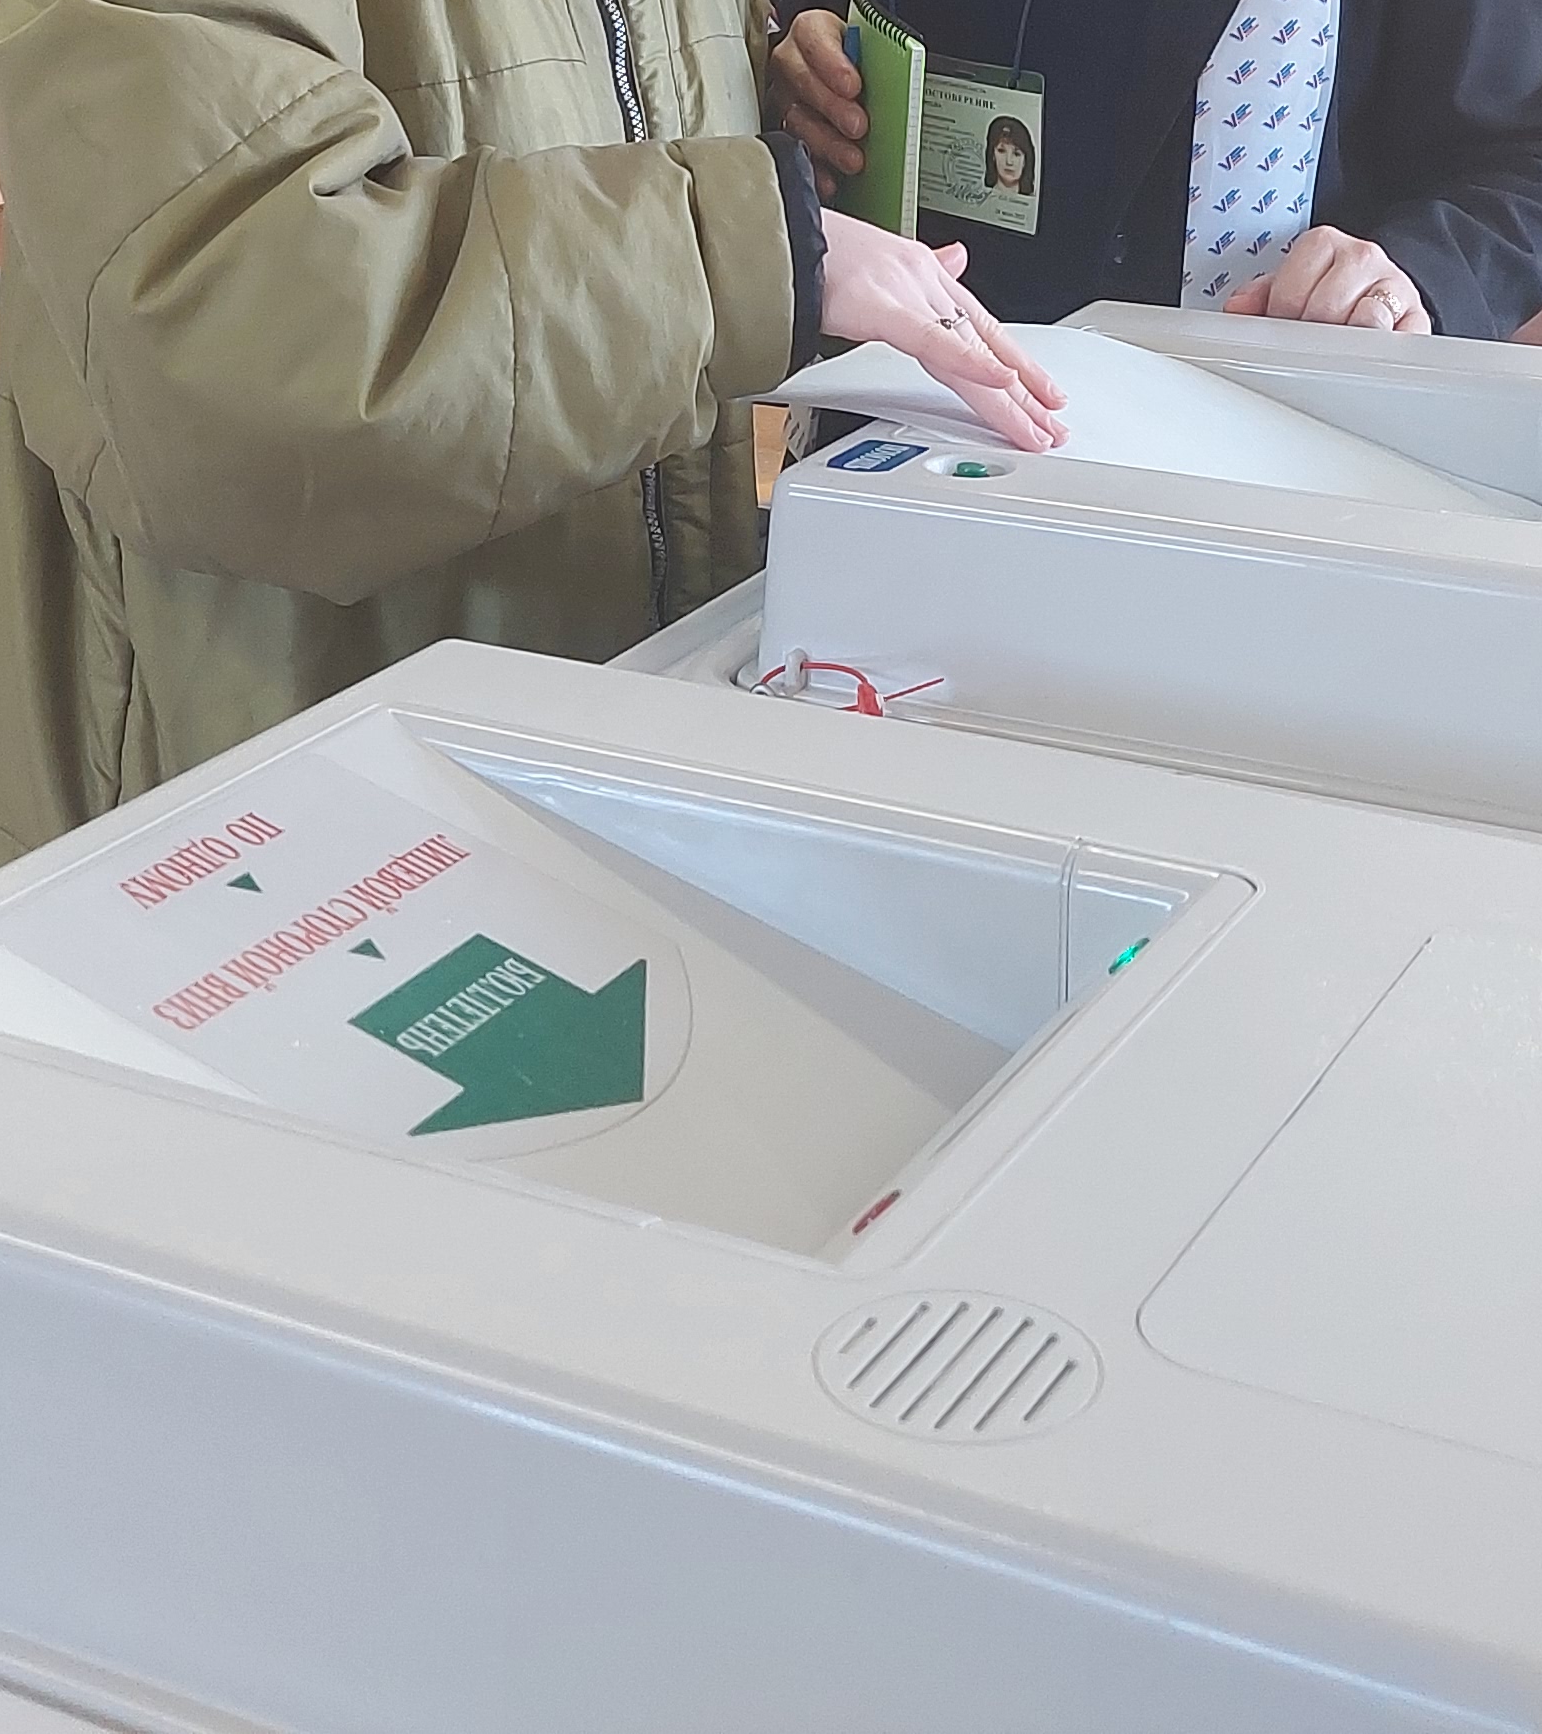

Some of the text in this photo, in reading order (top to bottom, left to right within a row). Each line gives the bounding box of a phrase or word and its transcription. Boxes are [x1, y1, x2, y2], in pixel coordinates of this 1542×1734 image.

[925, 87, 997, 111] ОСТОВЕРЕНИЕ
[118, 811, 287, 911] ПО ОДНОМУ
[151, 833, 472, 1032] ЛИЦЕВОЙ СТОРОНОЙ ВНИЗ
[395, 956, 550, 1058] БЮЛЛЕТЕНЬ
